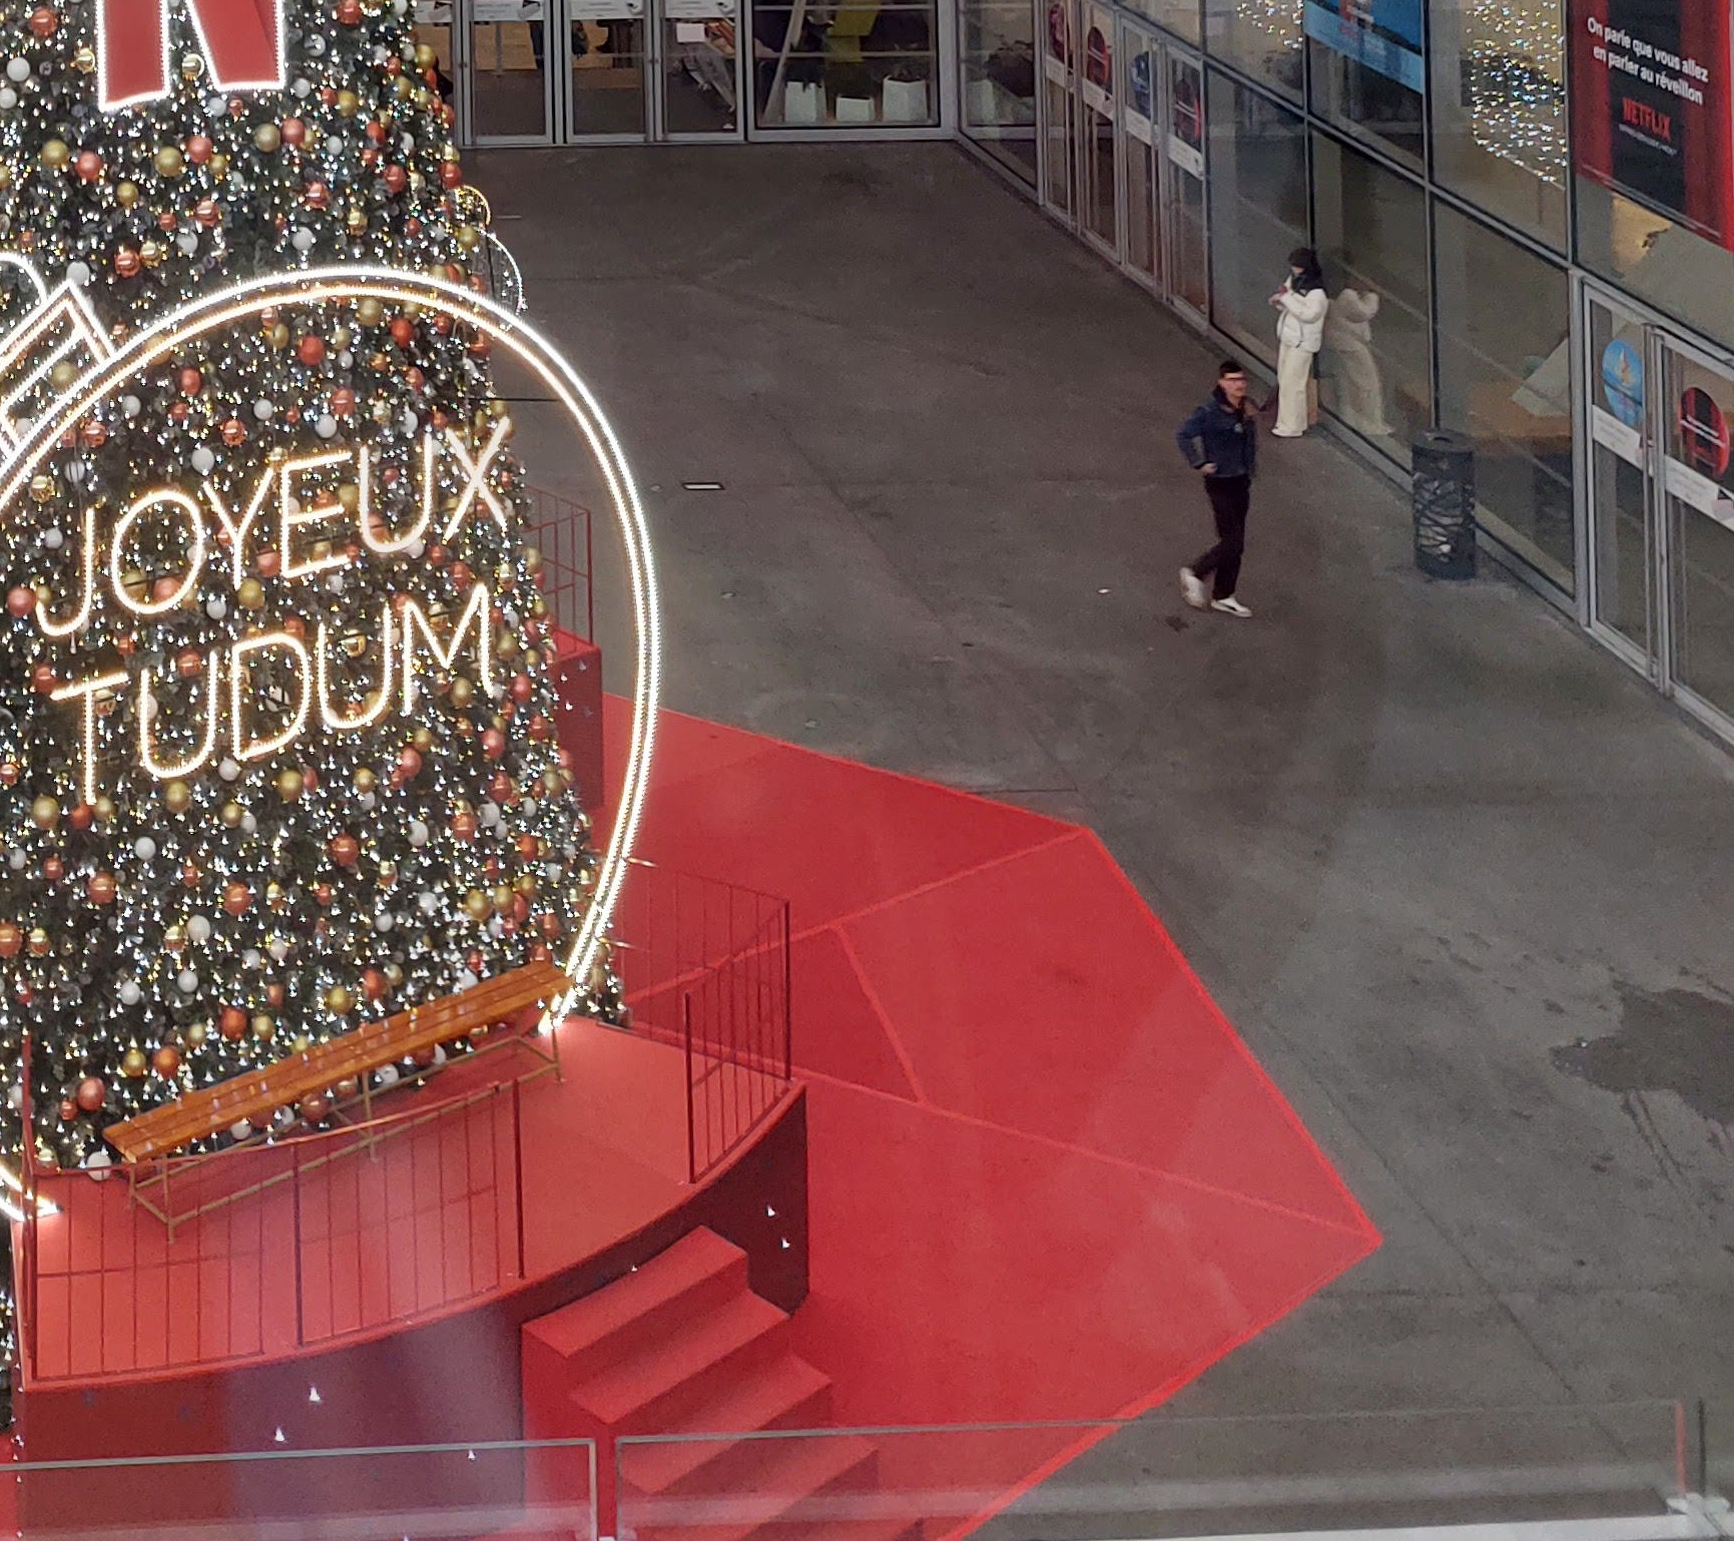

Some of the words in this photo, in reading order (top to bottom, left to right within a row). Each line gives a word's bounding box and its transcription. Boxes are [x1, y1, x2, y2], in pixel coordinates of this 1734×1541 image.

[1587, 17, 1603, 37] On
[1604, 26, 1631, 49] parie
[1632, 39, 1653, 58] que
[1654, 48, 1680, 71] vous
[1682, 58, 1709, 83] allez
[1593, 45, 1606, 64] en
[1608, 51, 1639, 77] parler
[1640, 67, 1653, 84] au
[1655, 70, 1703, 106] réveillon
[1622, 97, 1672, 141] NETFLIX
[34, 417, 512, 638] JOYEUX
[49, 581, 496, 807] TUDUM
